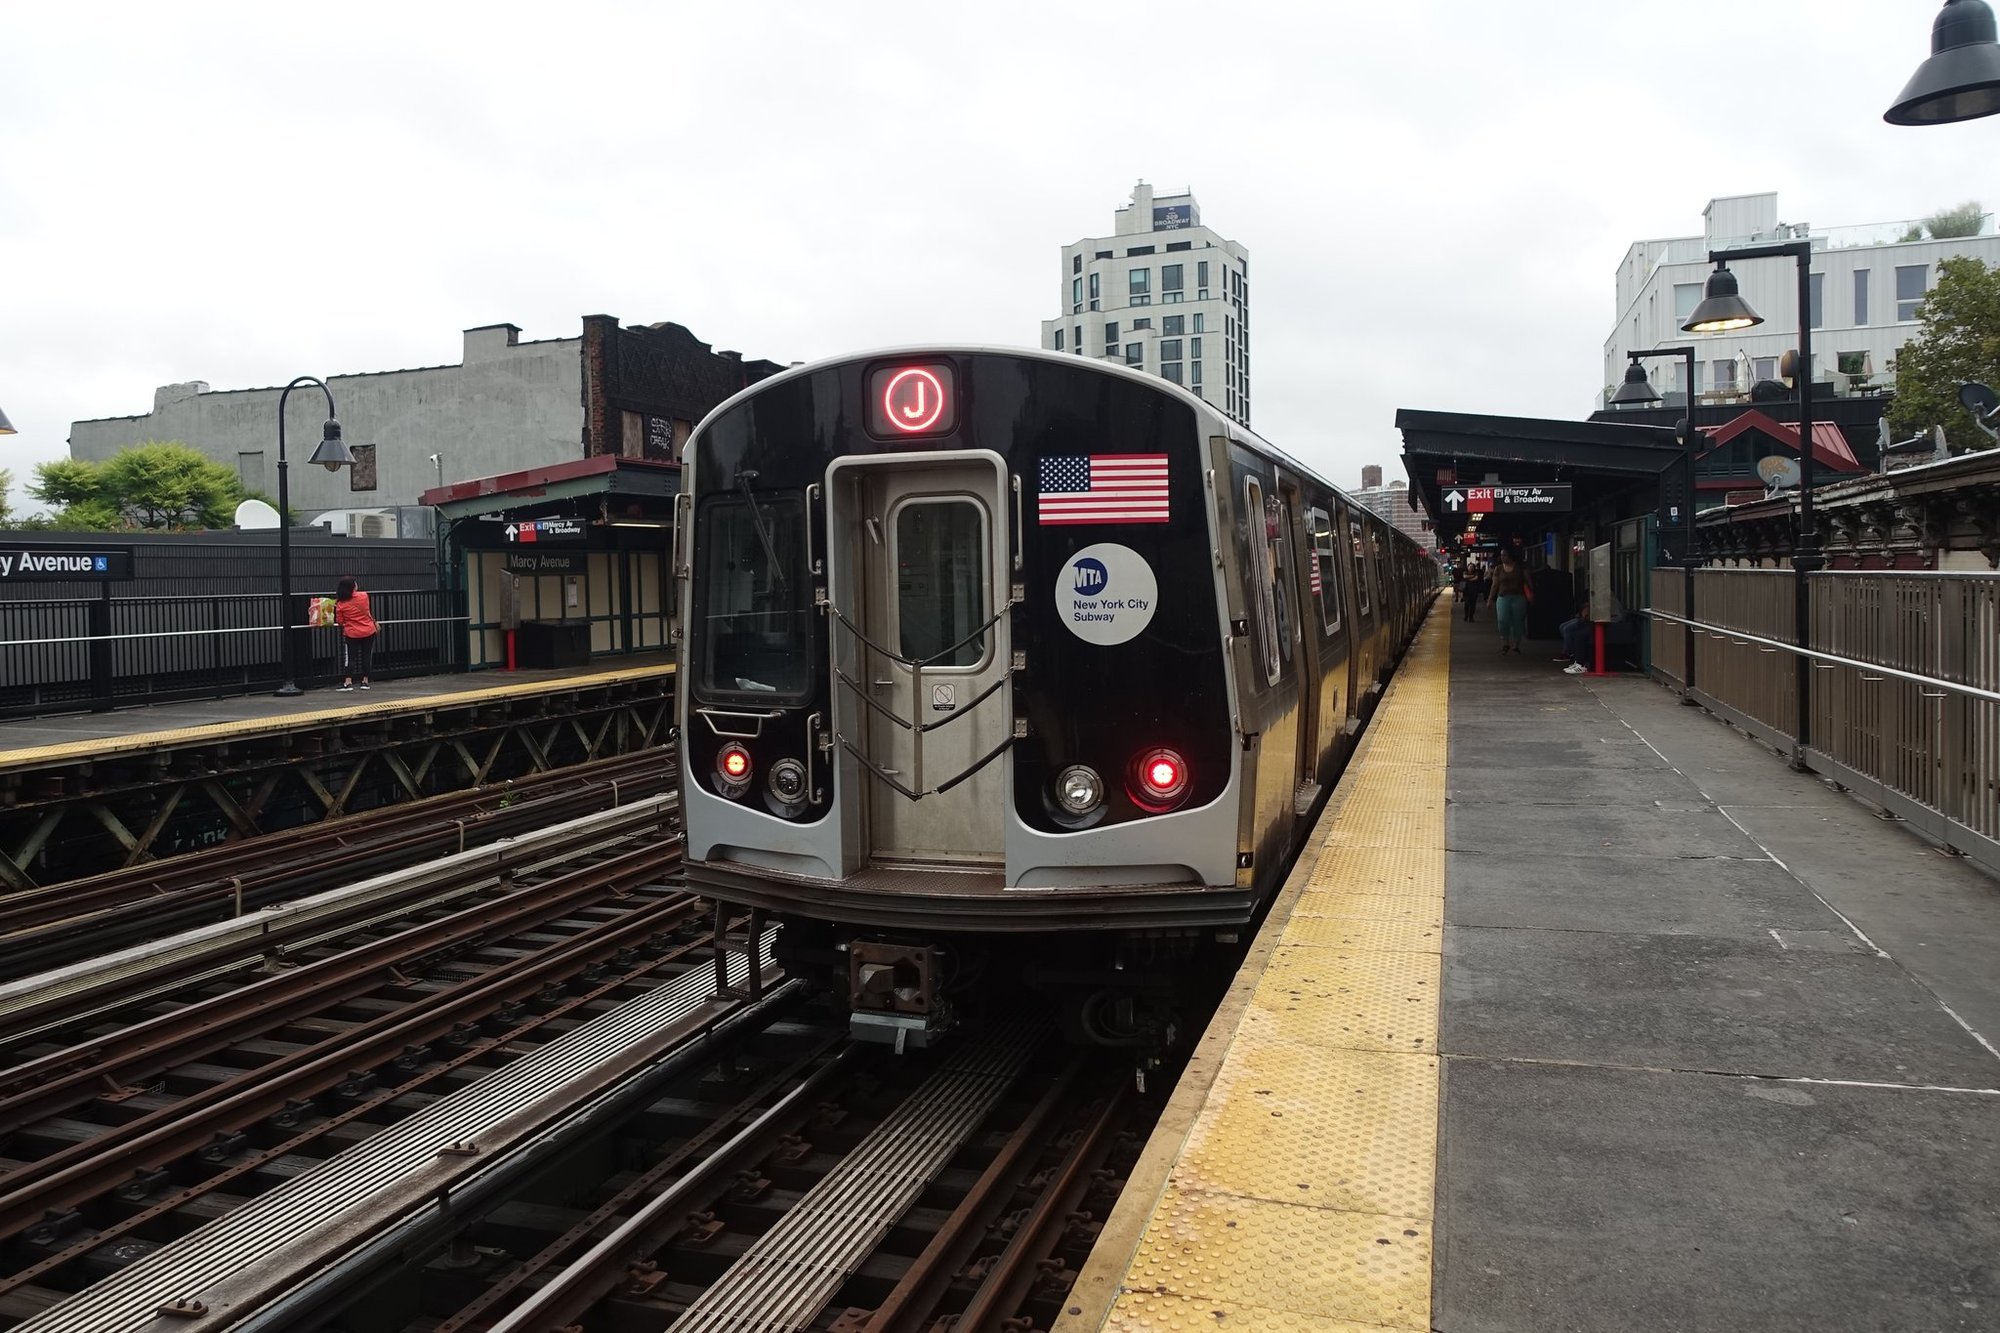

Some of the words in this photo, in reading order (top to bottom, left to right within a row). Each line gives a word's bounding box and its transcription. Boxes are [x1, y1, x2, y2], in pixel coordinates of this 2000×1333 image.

[1154, 218, 1190, 226] BROADWAY
[903, 381, 924, 418] J
[1467, 488, 1491, 499] Exit
[1504, 488, 1529, 497] Marcy
[1531, 487, 1542, 495] Av
[1513, 495, 1554, 504] Broadway
[520, 521, 535, 531] Exit
[549, 520, 565, 528] Marcy
[555, 526, 581, 534] Broadway
[0, 556, 13, 576] y
[19, 552, 92, 571] Avenue
[510, 554, 537, 570] Marcy
[540, 555, 570, 568] Avenue
[1073, 566, 1102, 589] MTA
[1073, 600, 1098, 610] New
[1100, 599, 1125, 609] York
[1127, 599, 1149, 610] City
[1073, 612, 1115, 622] Subway
